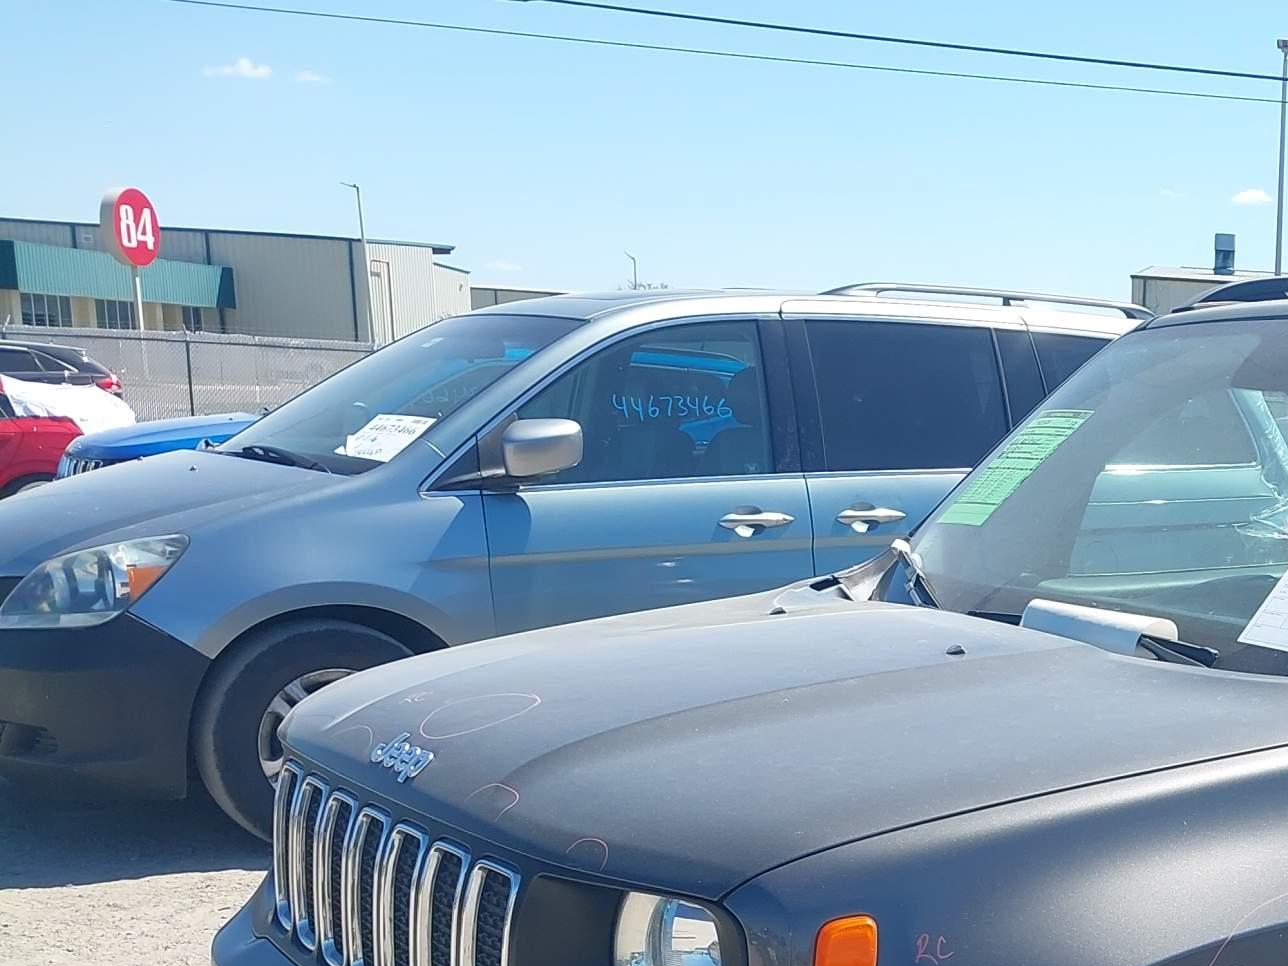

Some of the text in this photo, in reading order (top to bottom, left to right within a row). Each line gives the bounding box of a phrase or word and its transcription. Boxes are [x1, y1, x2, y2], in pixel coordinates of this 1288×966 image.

[120, 204, 155, 250] 84
[612, 394, 733, 422] 44673466
[370, 731, 434, 784] Jeep
[914, 933, 955, 966] RC
